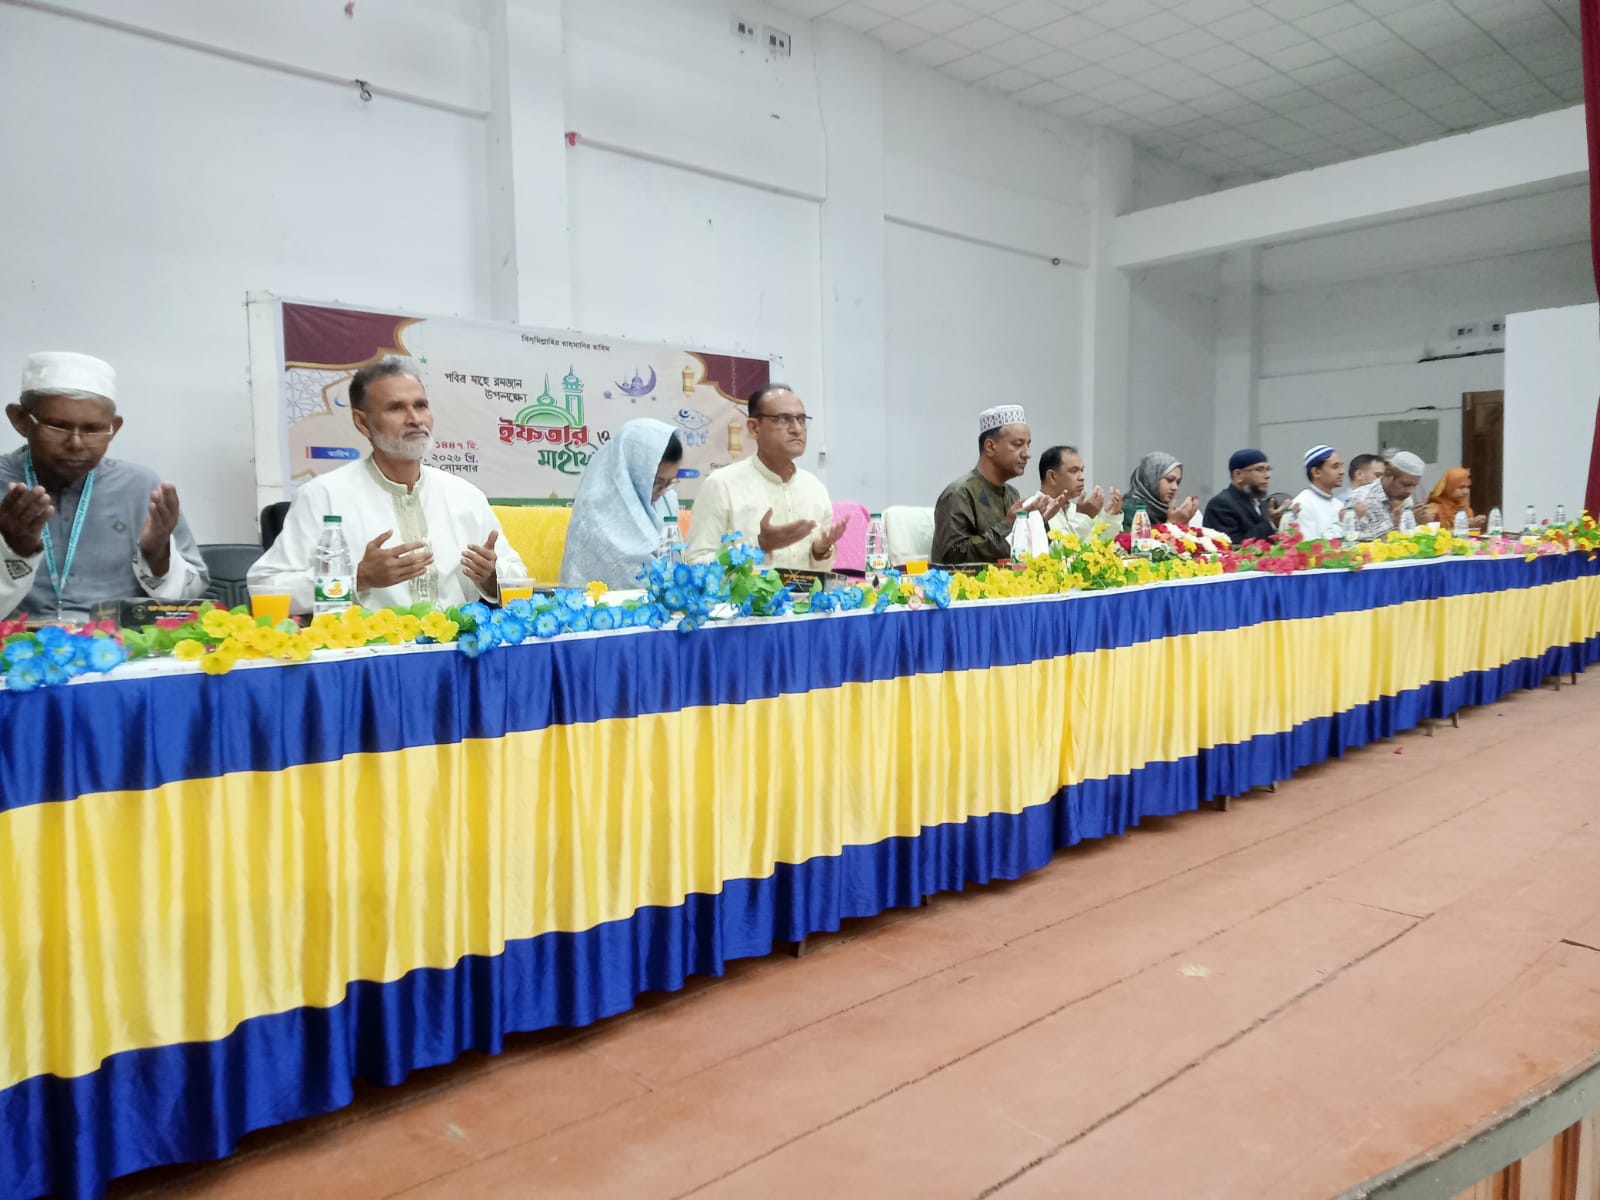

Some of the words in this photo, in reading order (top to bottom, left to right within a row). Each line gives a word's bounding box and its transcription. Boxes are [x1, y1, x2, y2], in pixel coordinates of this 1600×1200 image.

[444, 371, 466, 384] পবিত্র
[470, 374, 490, 388] মাহে
[493, 377, 523, 389] রমজান
[498, 416, 587, 446] ইফতার
[435, 441, 464, 450] ১৪৪৭
[432, 453, 462, 463] ২০২৬
[439, 464, 478, 473] সোমবার
